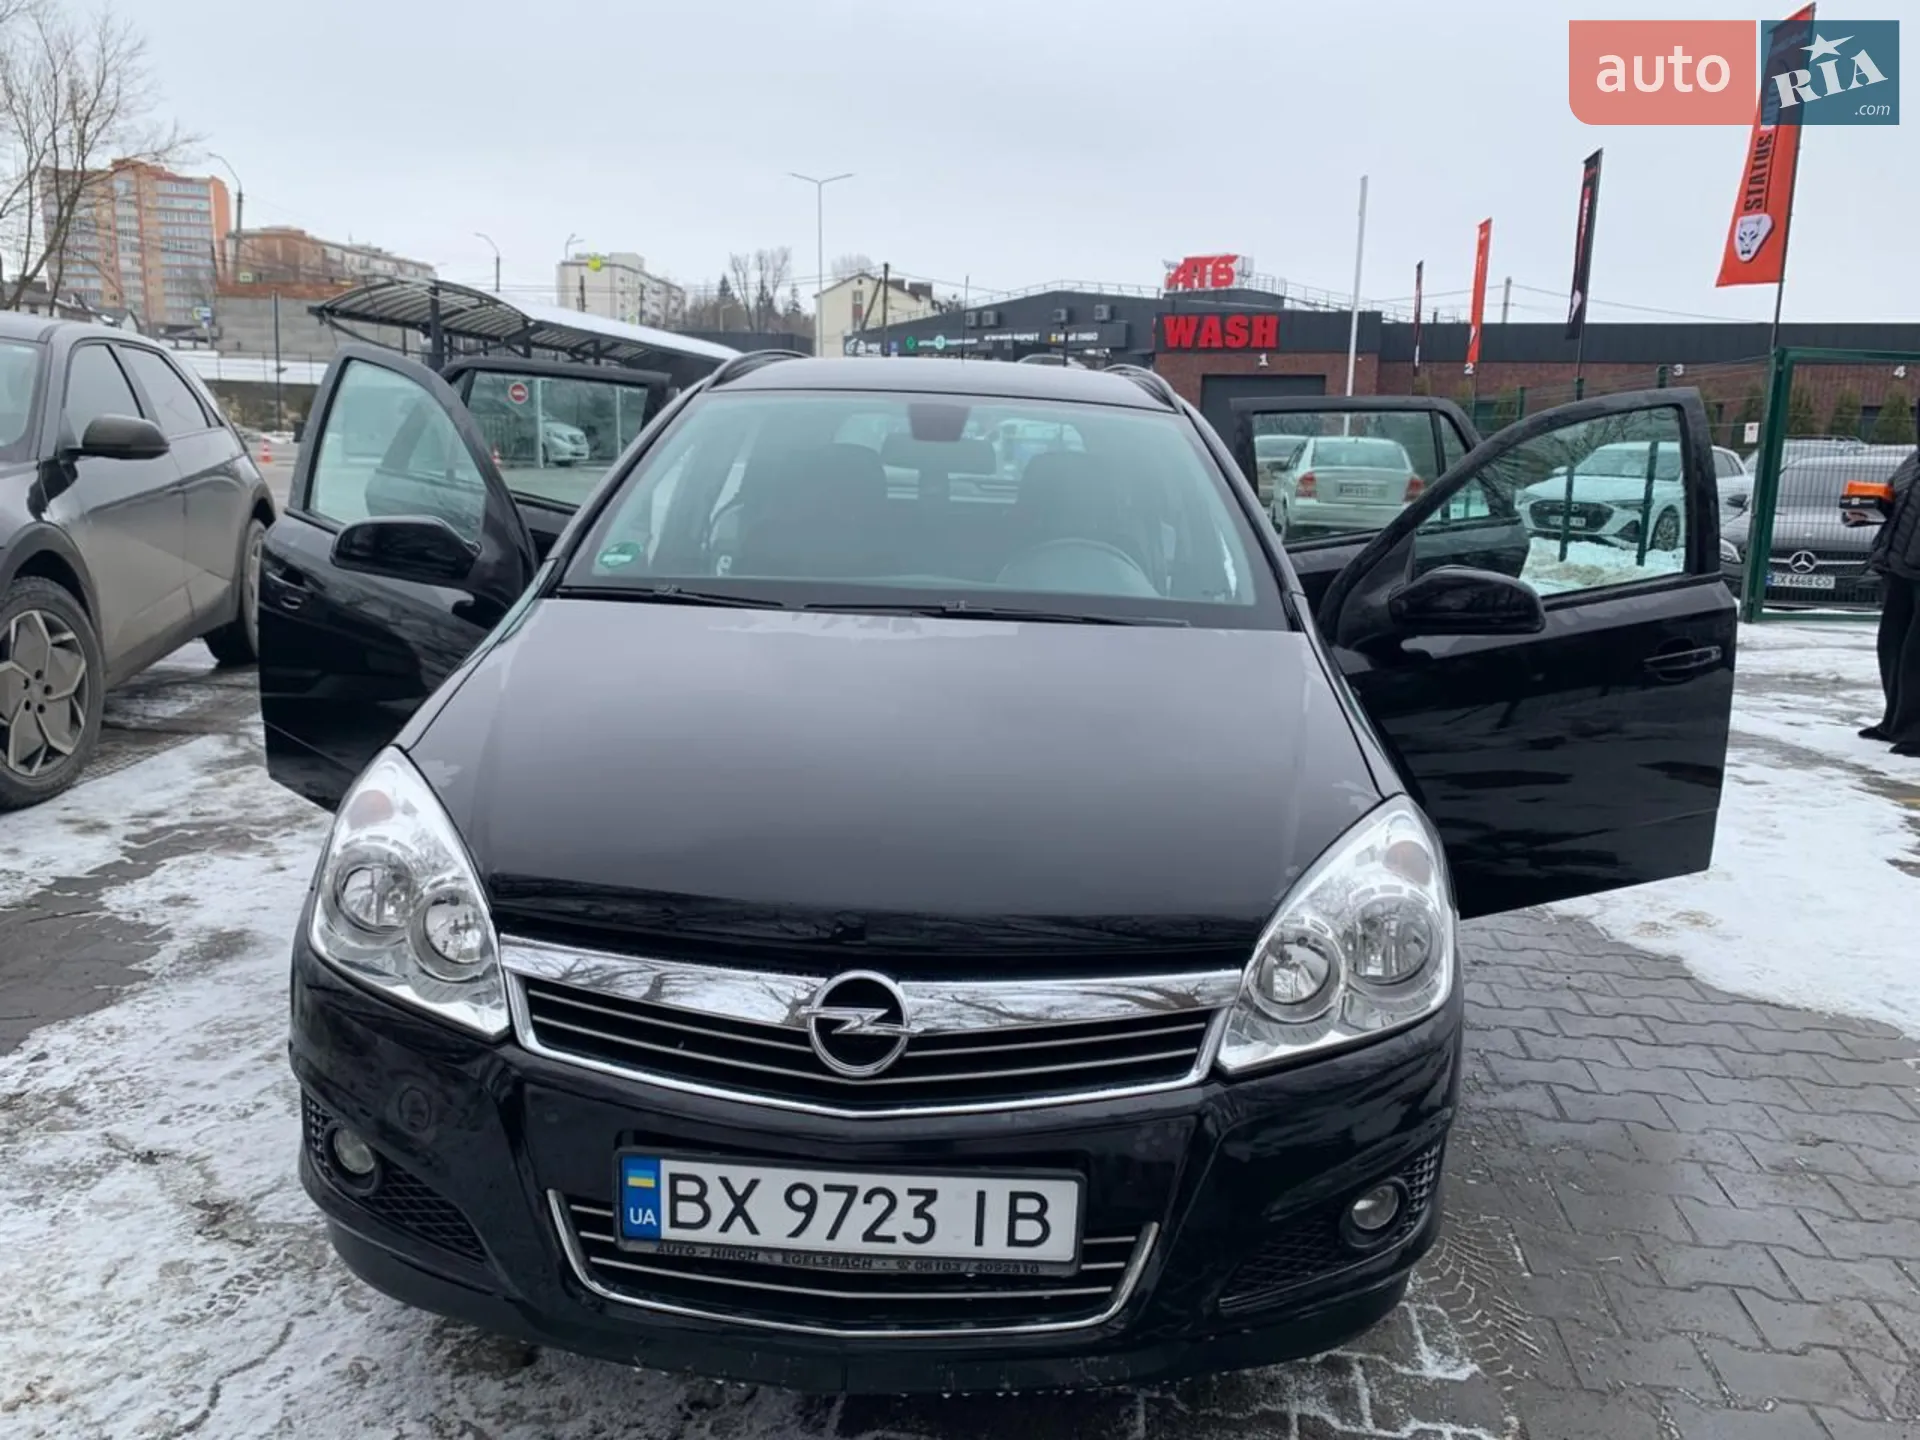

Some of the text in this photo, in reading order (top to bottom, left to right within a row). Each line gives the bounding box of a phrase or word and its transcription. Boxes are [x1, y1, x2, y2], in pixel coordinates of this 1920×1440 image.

[1743, 132, 1774, 213] STATUS
[1163, 314, 1279, 349] WASH
[1258, 353, 1269, 367] 1
[1463, 362, 1474, 375] 2
[1673, 364, 1685, 376] 3
[1893, 365, 1907, 378] 4
[629, 1207, 657, 1227] UA
[668, 1172, 1051, 1248] BX 9723 IB
[656, 1243, 697, 1256] AUTO
